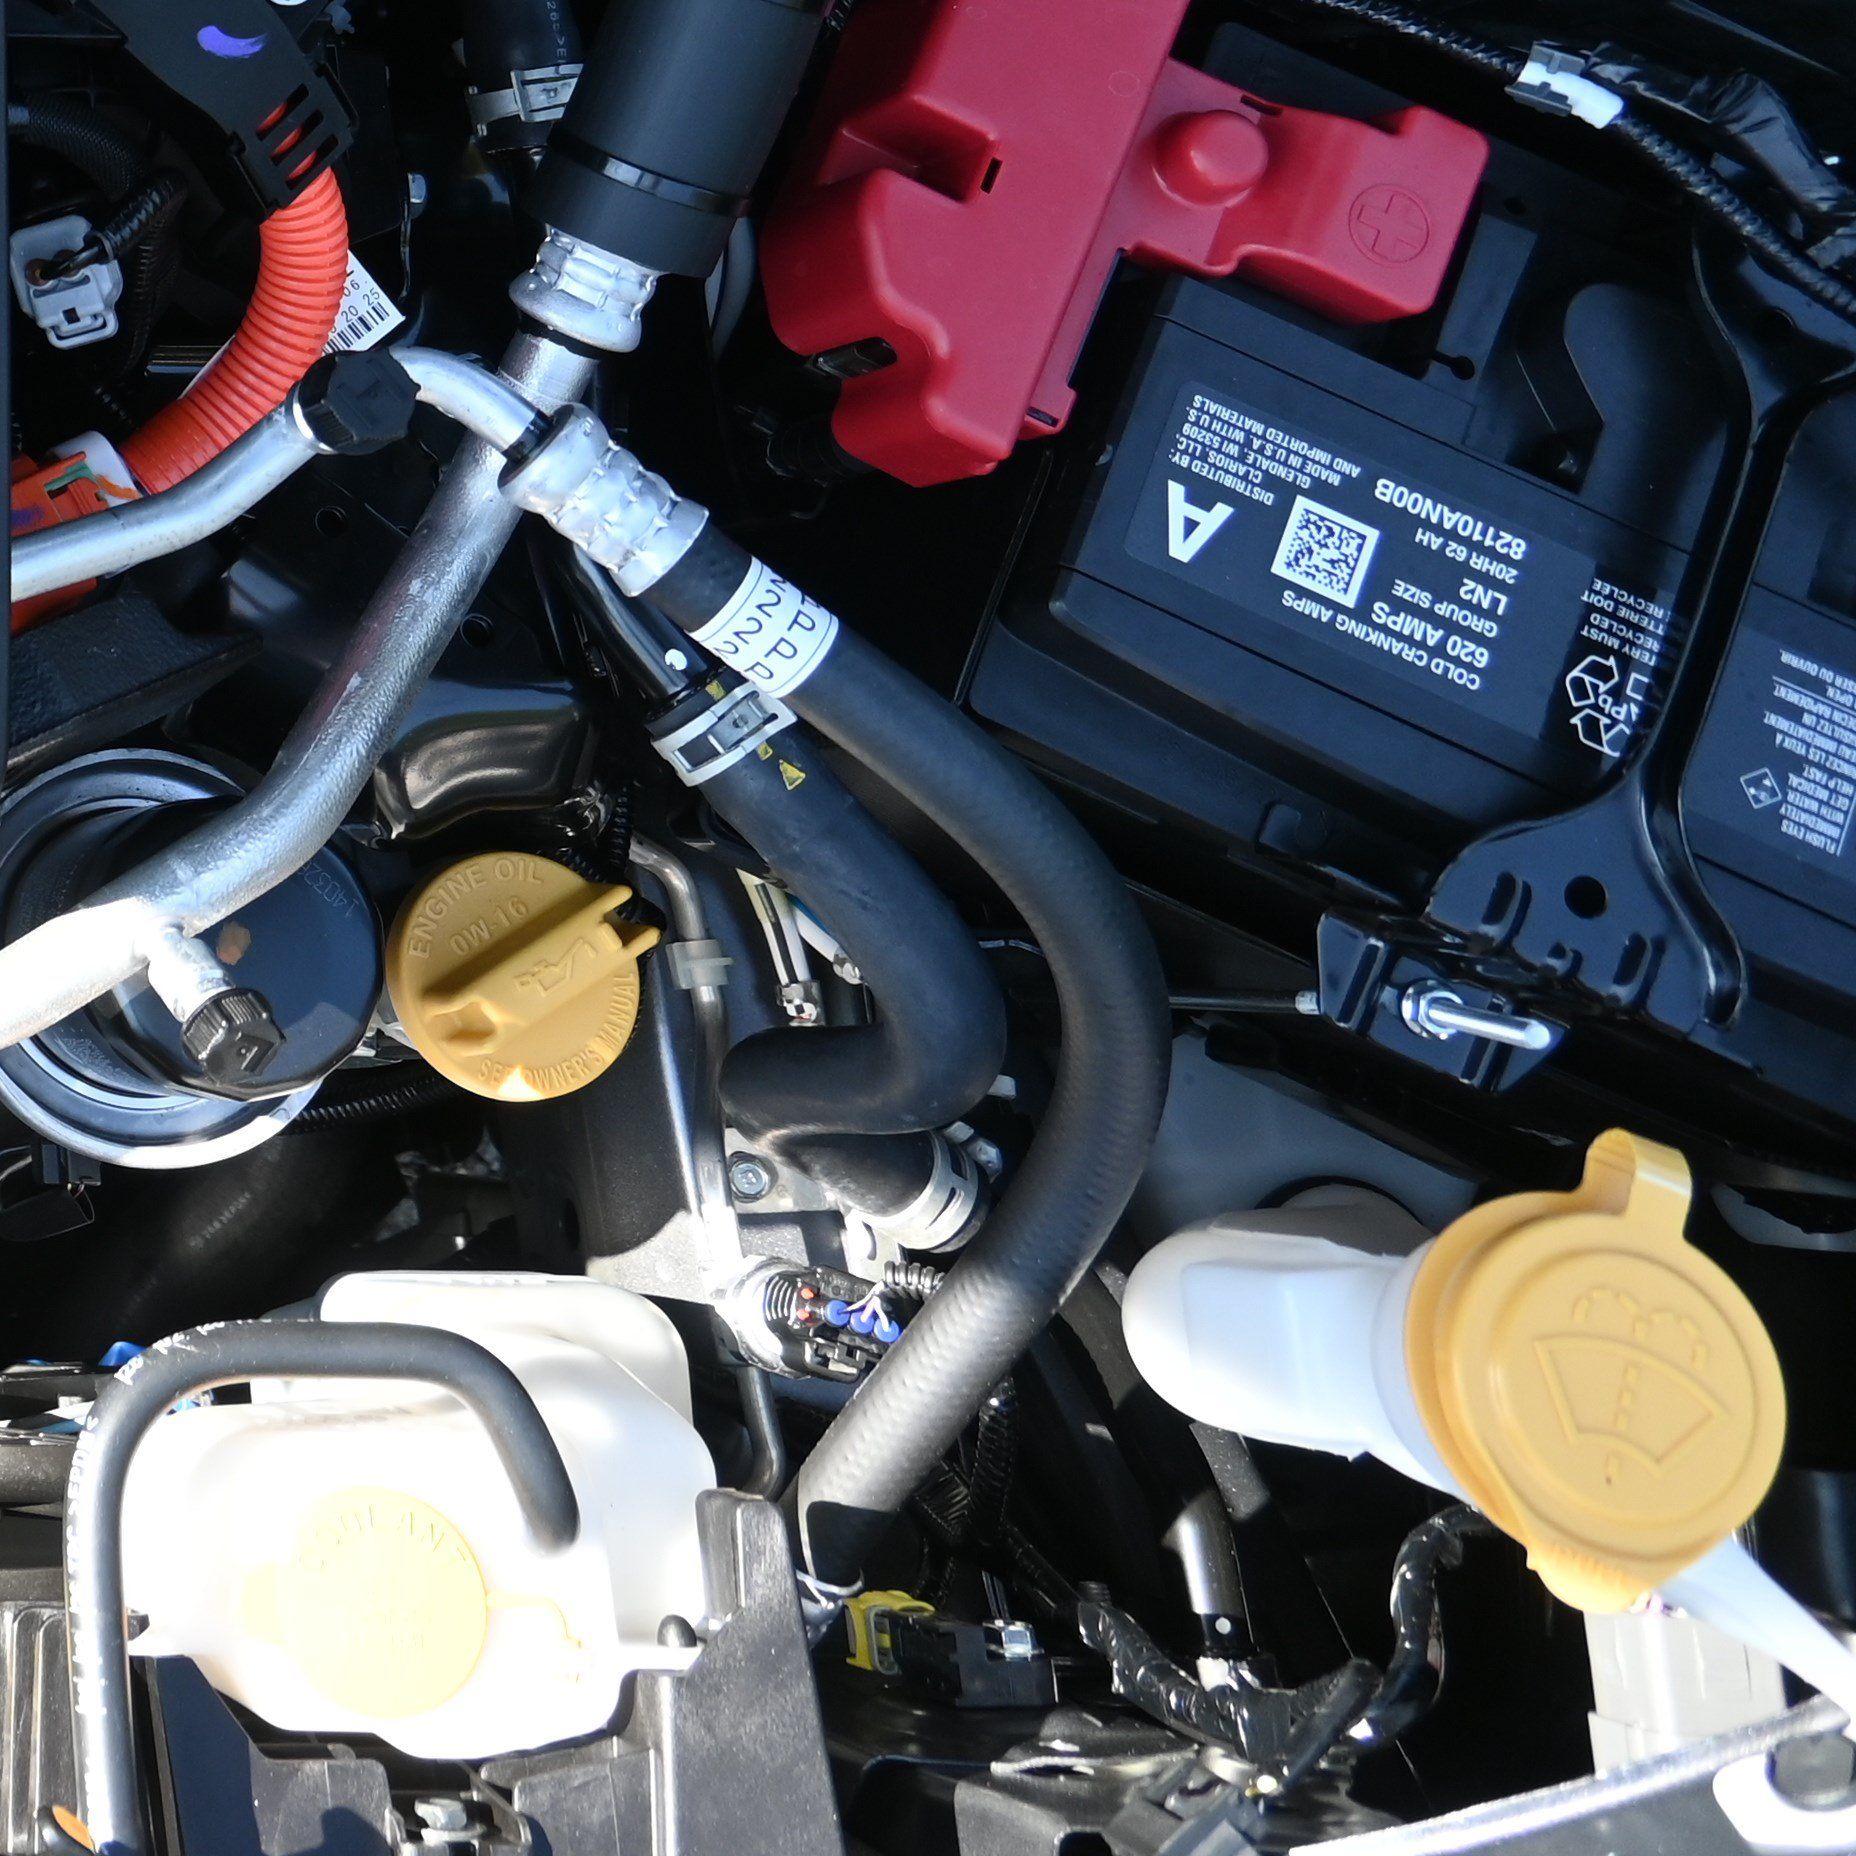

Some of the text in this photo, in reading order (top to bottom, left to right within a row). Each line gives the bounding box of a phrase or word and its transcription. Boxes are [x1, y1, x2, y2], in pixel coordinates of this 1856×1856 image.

[1179, 420, 1313, 489] GLENDALE, WI 53209
[1181, 404, 1343, 486] MADE IN U.S.A. WITH U.S.
[1190, 392, 1362, 478] AND IMPORTED MATERIALS
[1165, 446, 1276, 506] DISTRIBUTED BY:
[1167, 478, 1237, 564] A
[1370, 474, 1530, 561] 82110AN00B
[1412, 525, 1519, 585] 20HR 62 AH
[1388, 577, 1501, 639] GROUP SIZE
[1455, 576, 1510, 615] LN2
[1578, 587, 1667, 634] TTERIE DOIT
[1277, 587, 1484, 692] COLD CRANKING AMPS
[1367, 598, 1492, 669] 620 AMPS
[1579, 622, 1659, 666] TERY MUST
[1597, 693, 1630, 720] Pb
[1778, 817, 1838, 854] FLUSH EYES
[407, 856, 544, 959] ENGINE OIL
[600, 972, 638, 1053] MANUAL
